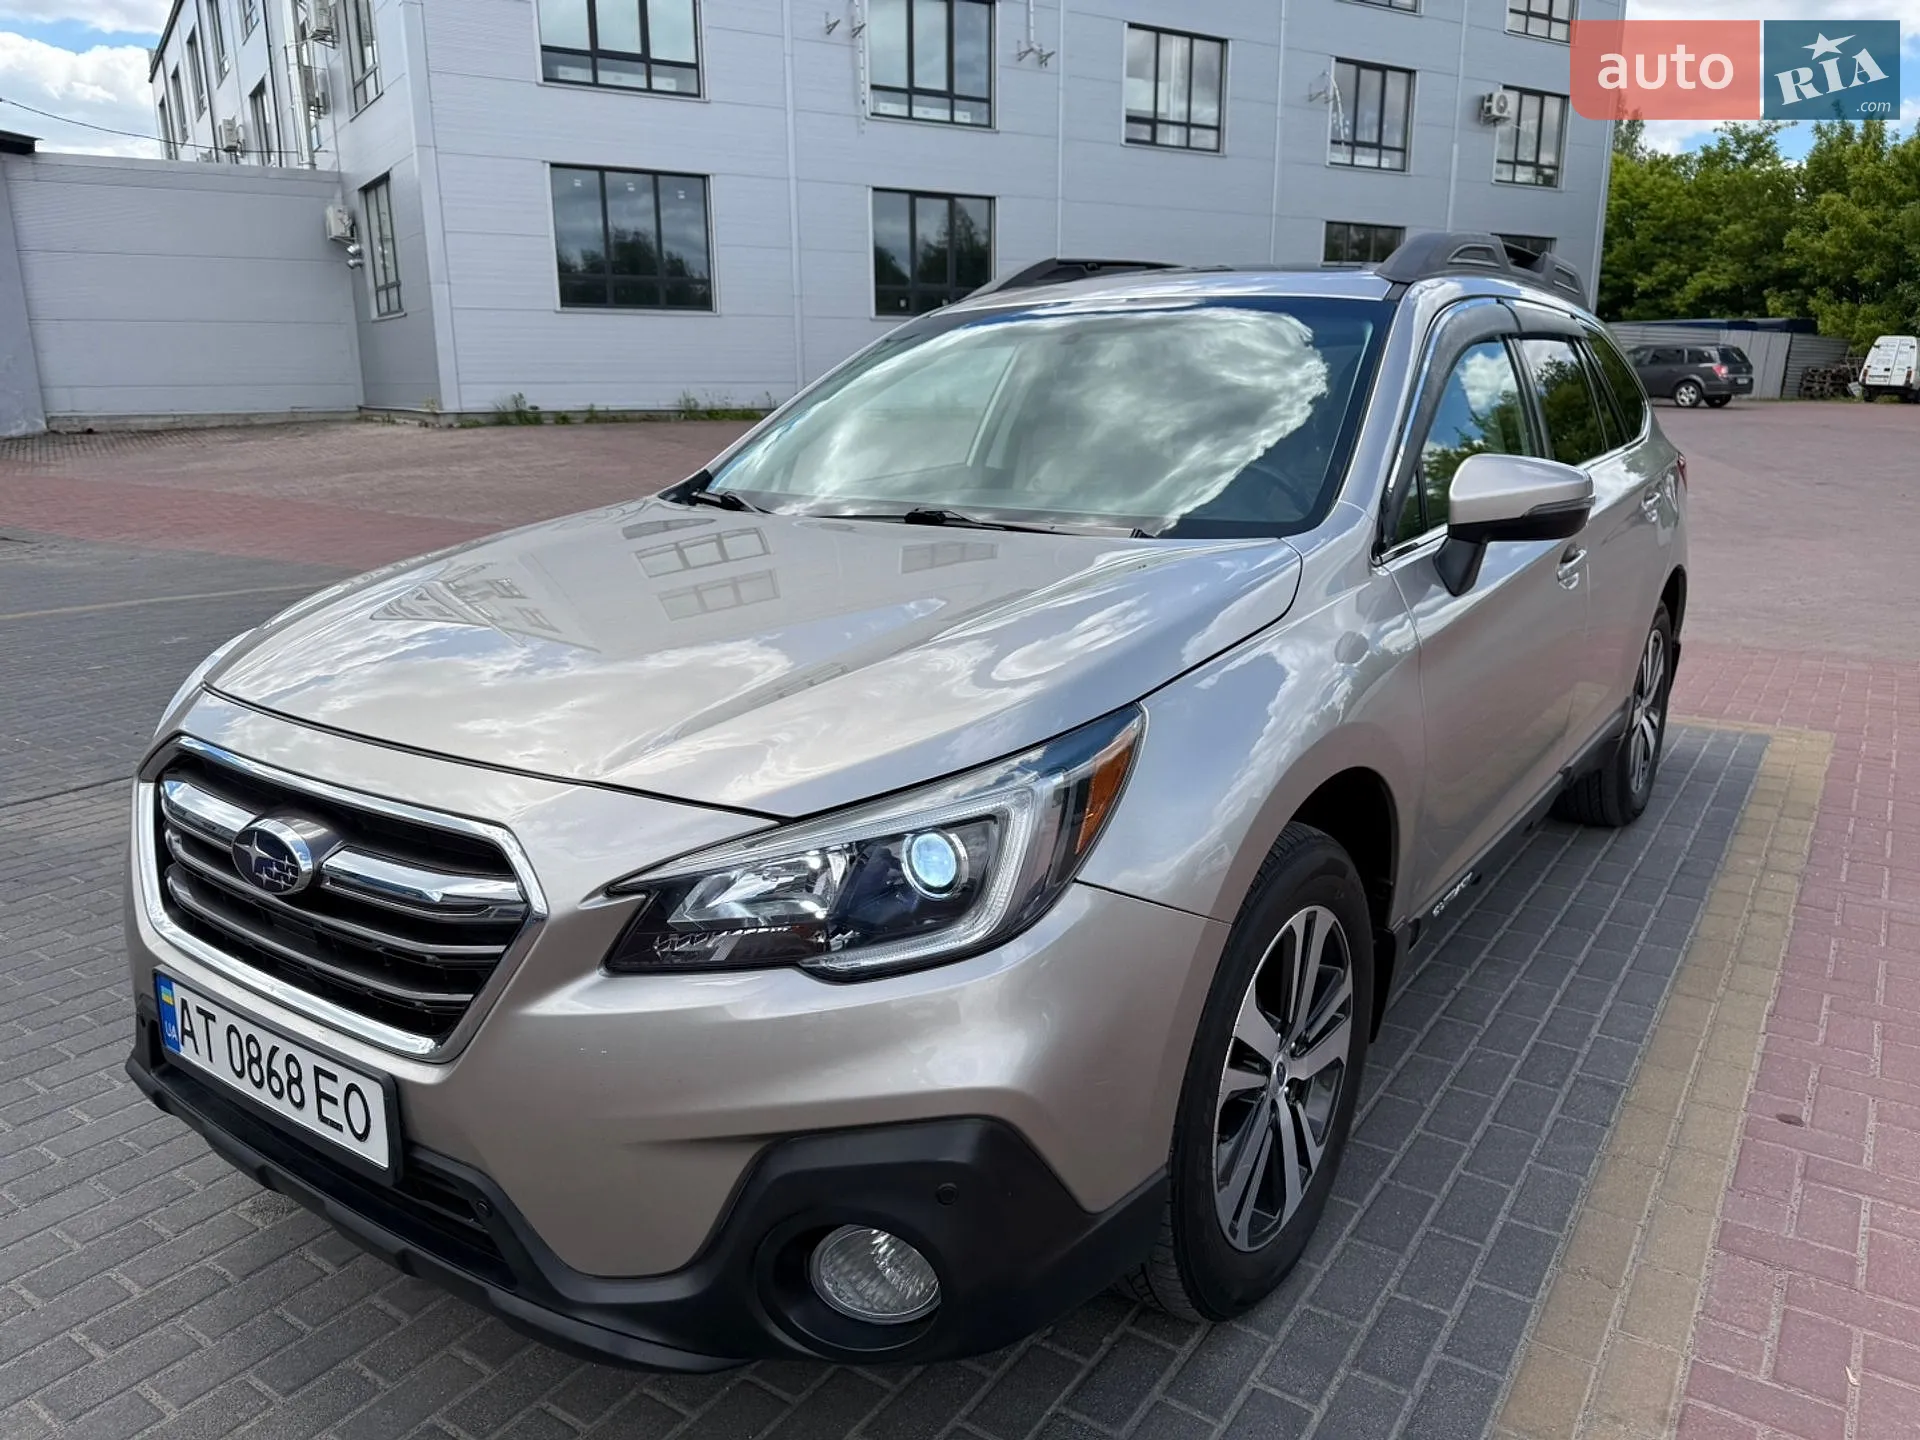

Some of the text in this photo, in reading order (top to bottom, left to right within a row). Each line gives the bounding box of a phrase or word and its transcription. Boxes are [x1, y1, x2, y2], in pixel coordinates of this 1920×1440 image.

[165, 1020, 178, 1039] UA
[180, 997, 371, 1143] AT 0868 EO
